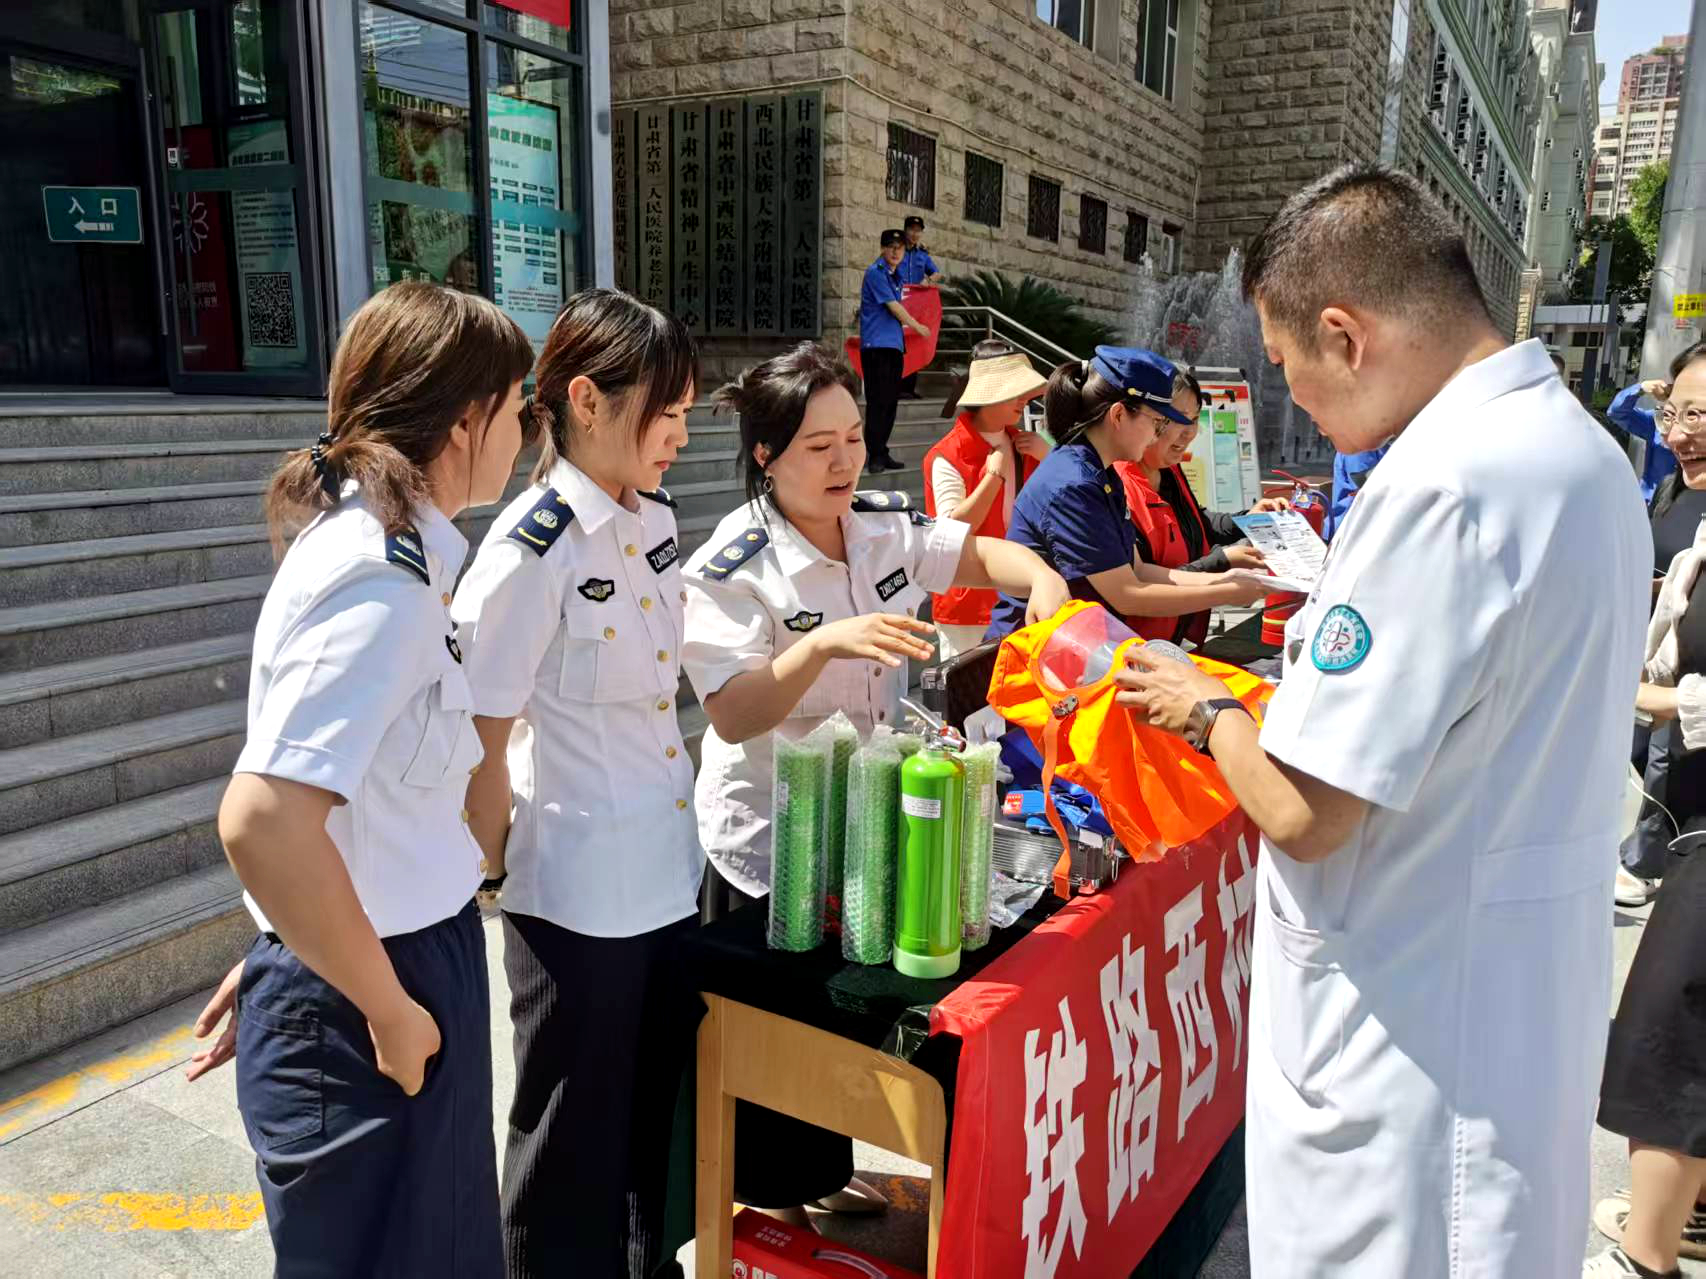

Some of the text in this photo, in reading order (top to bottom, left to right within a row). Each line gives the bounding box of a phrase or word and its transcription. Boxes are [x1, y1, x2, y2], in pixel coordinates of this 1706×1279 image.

[68, 196, 118, 216] 入口
[714, 109, 736, 328] 甘肃省中西医结合医院
[753, 103, 775, 329] 西北民族大学附属医院
[791, 98, 815, 330] 甘肃省第二人民医院
